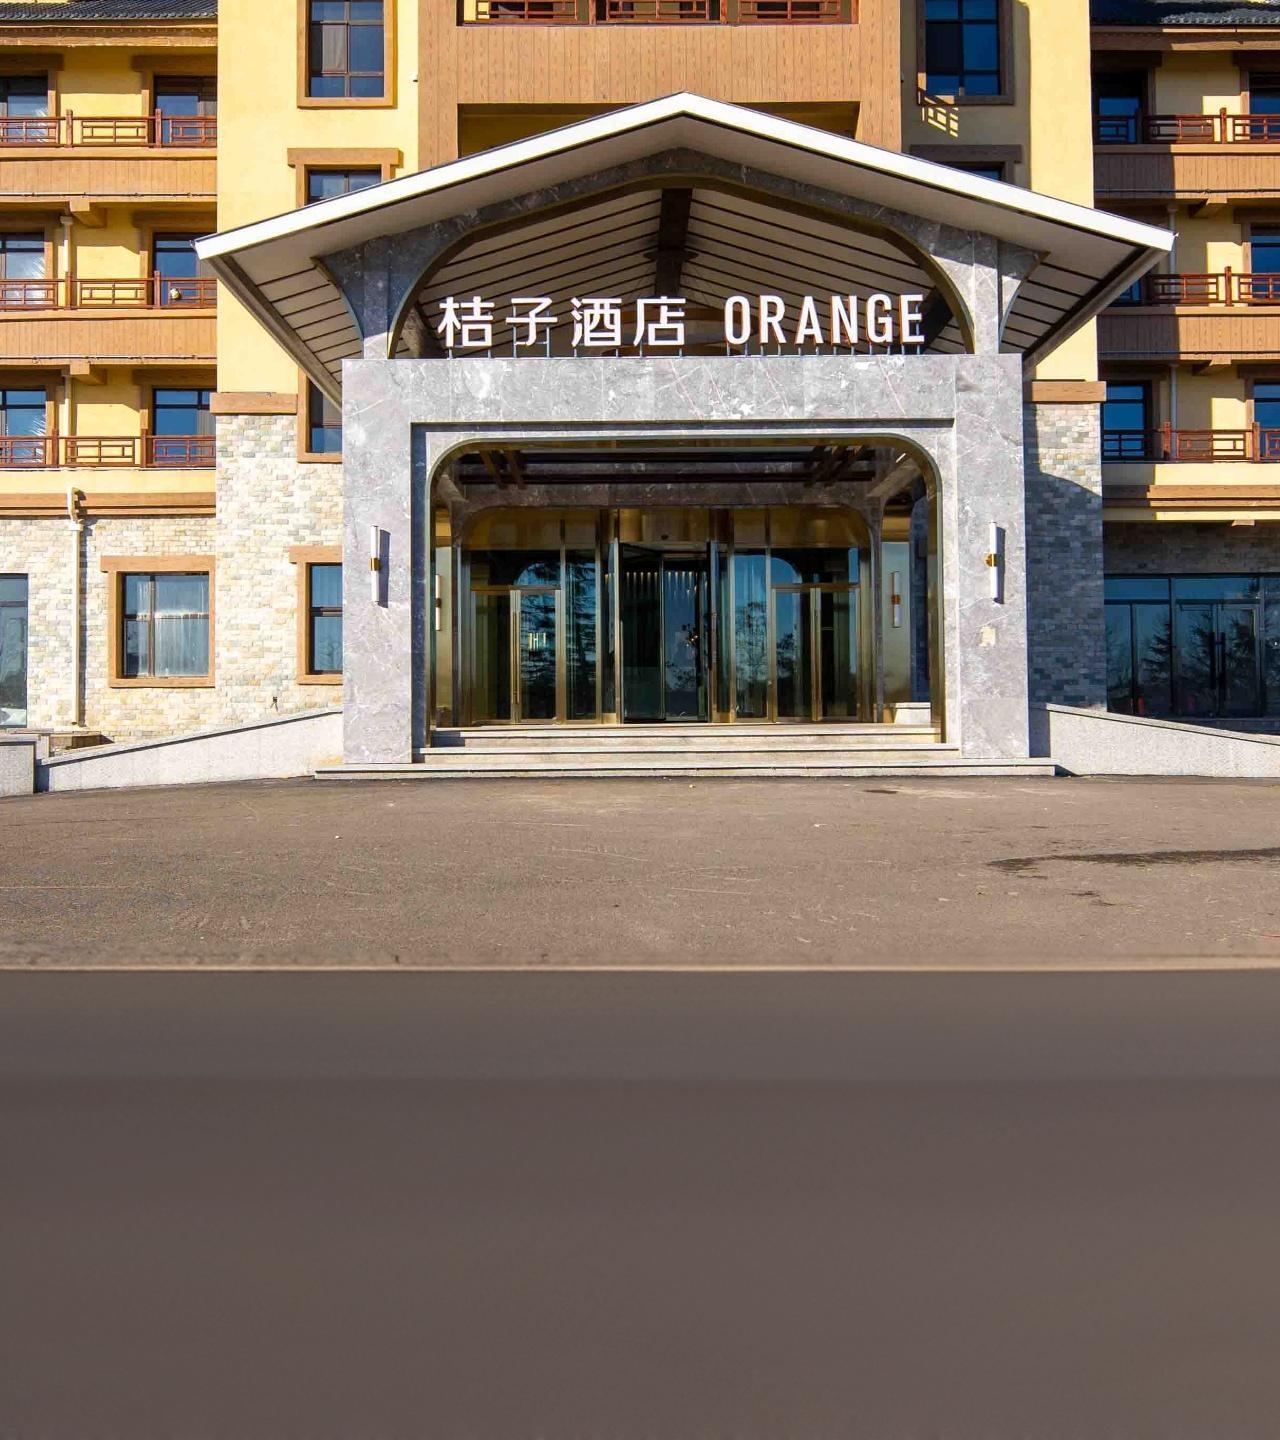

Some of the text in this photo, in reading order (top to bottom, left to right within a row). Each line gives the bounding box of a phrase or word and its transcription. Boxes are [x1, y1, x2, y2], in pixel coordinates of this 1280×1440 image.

[437, 294, 925, 347] 桔子酒店 ORANGE
